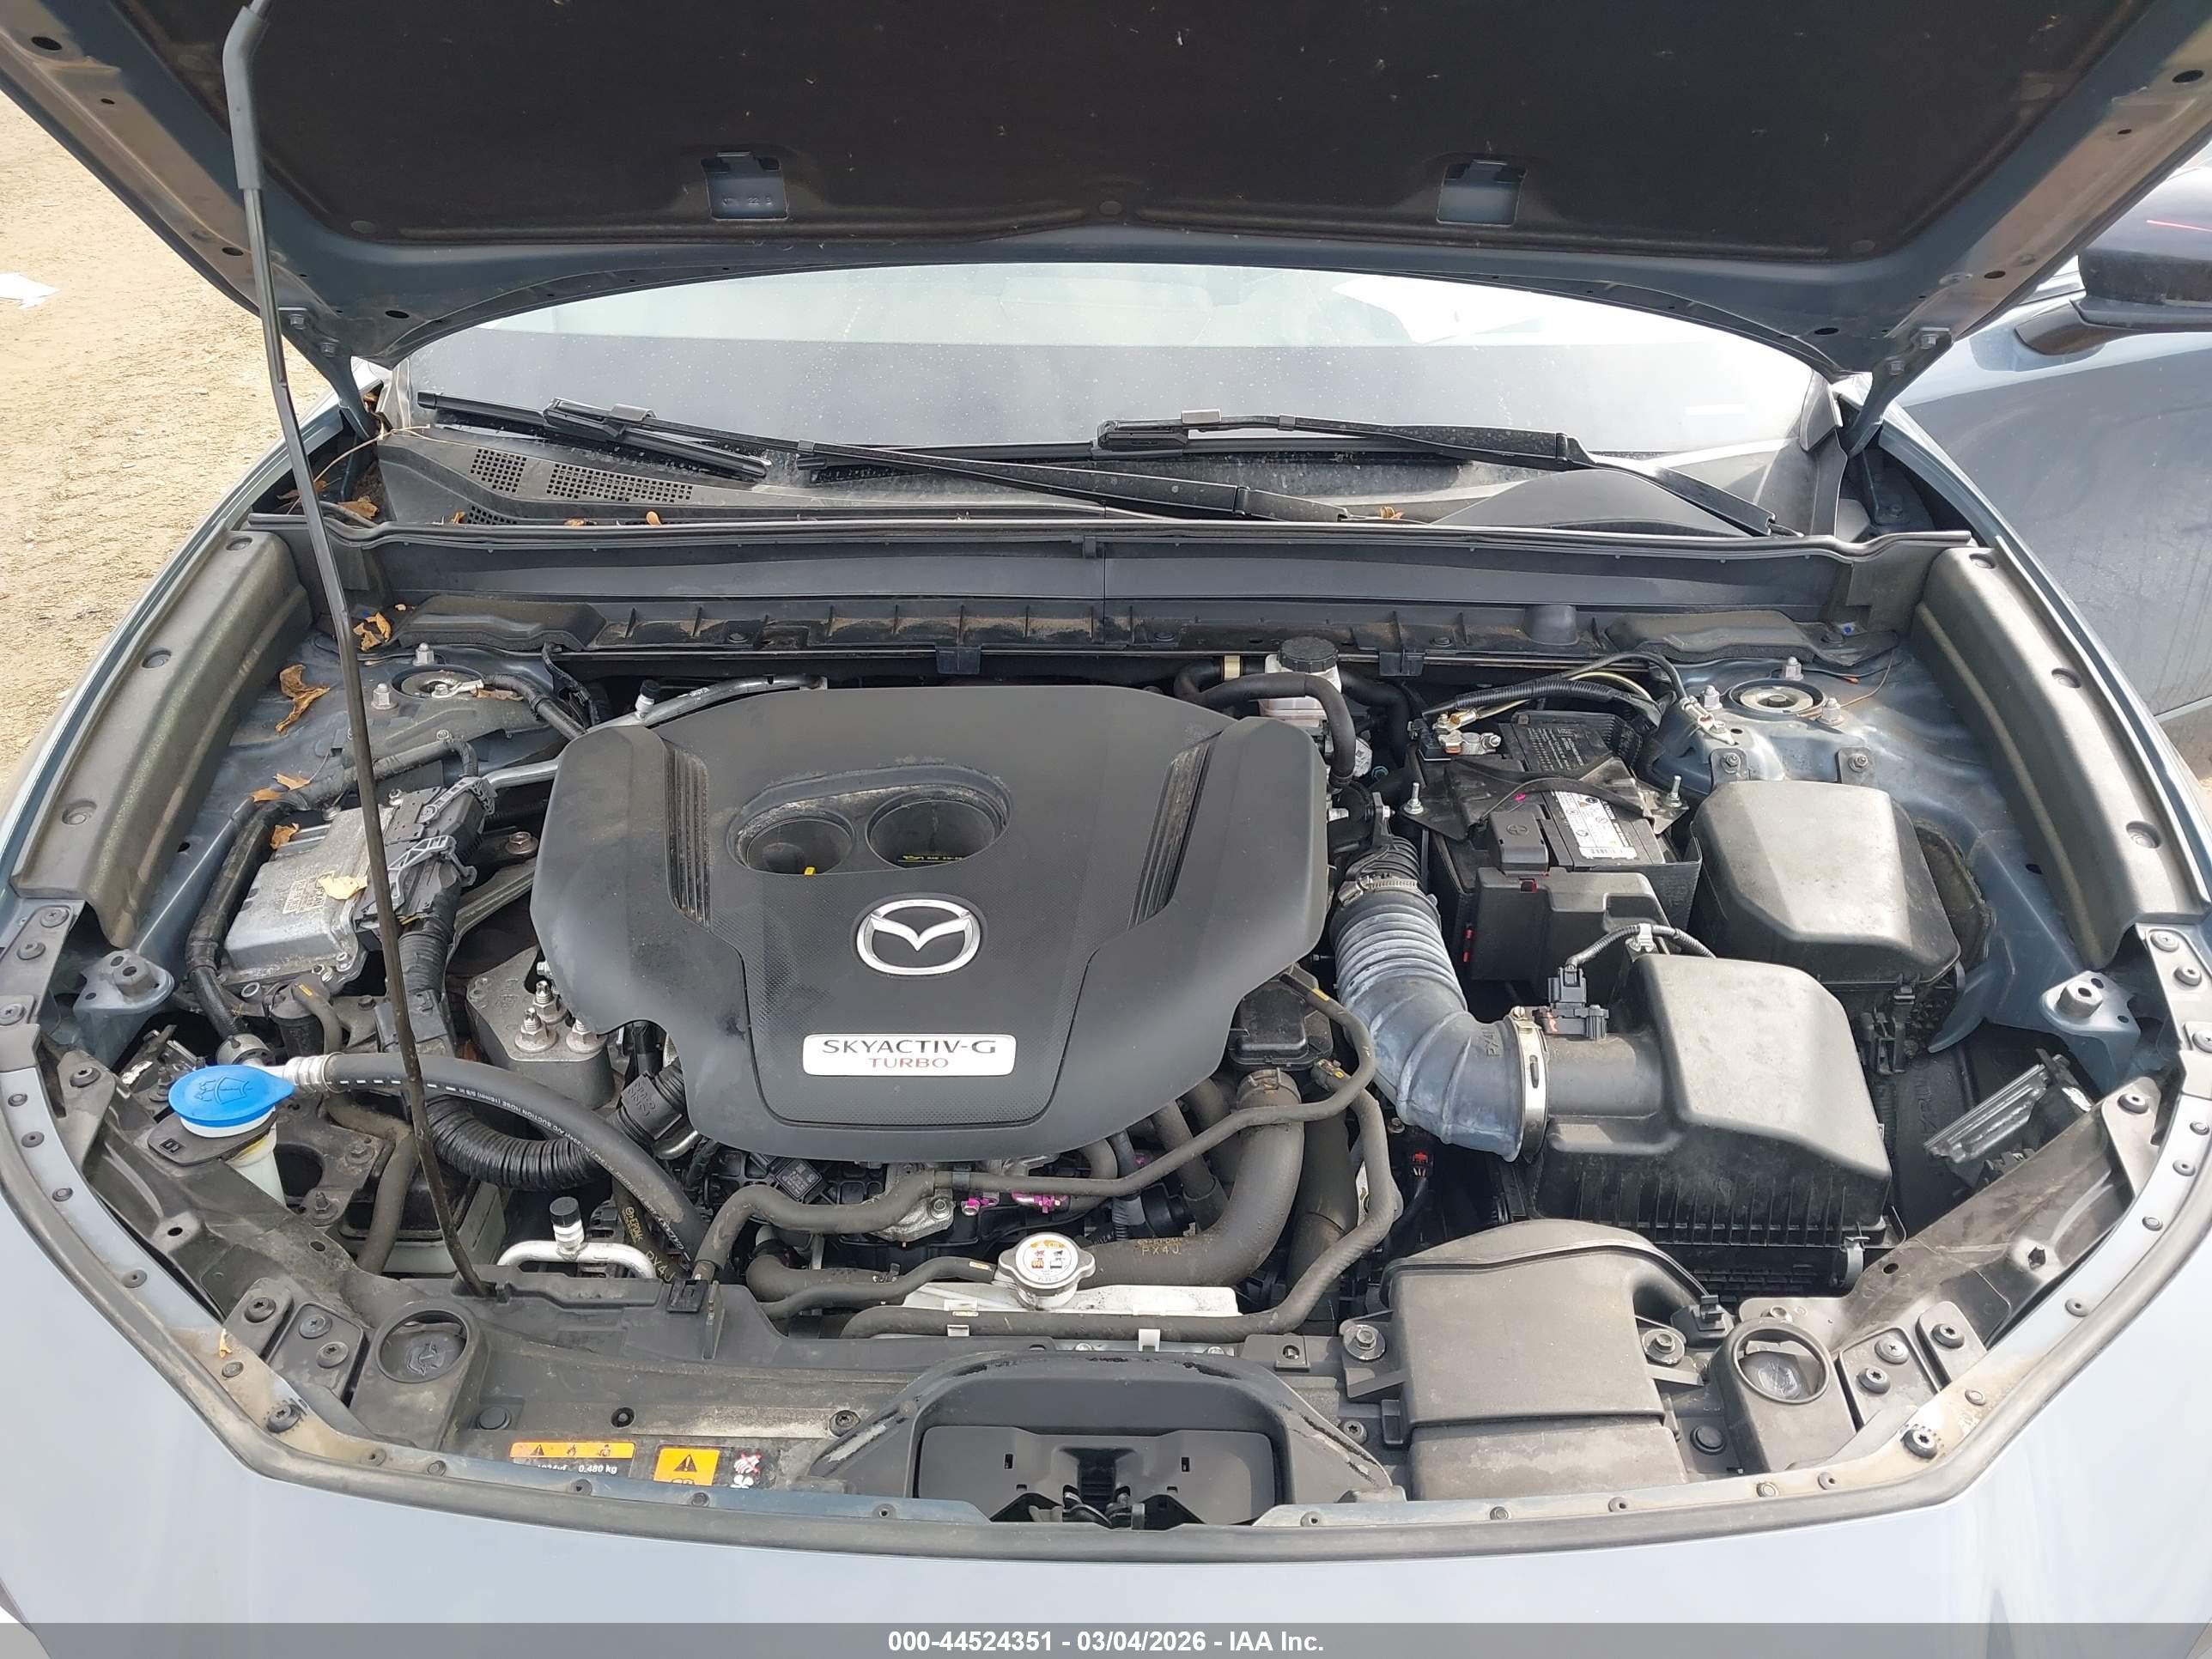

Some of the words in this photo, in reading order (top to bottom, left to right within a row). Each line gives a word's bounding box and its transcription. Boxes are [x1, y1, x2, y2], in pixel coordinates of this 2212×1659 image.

[822, 1039, 997, 1054] SKYACTIV-G
[869, 1057, 950, 1069] TURBO
[502, 1101, 521, 1113] HOSE
[522, 1109, 552, 1127] SUCTION
[578, 1464, 604, 1473] 0.480
[605, 1464, 618, 1474] kg
